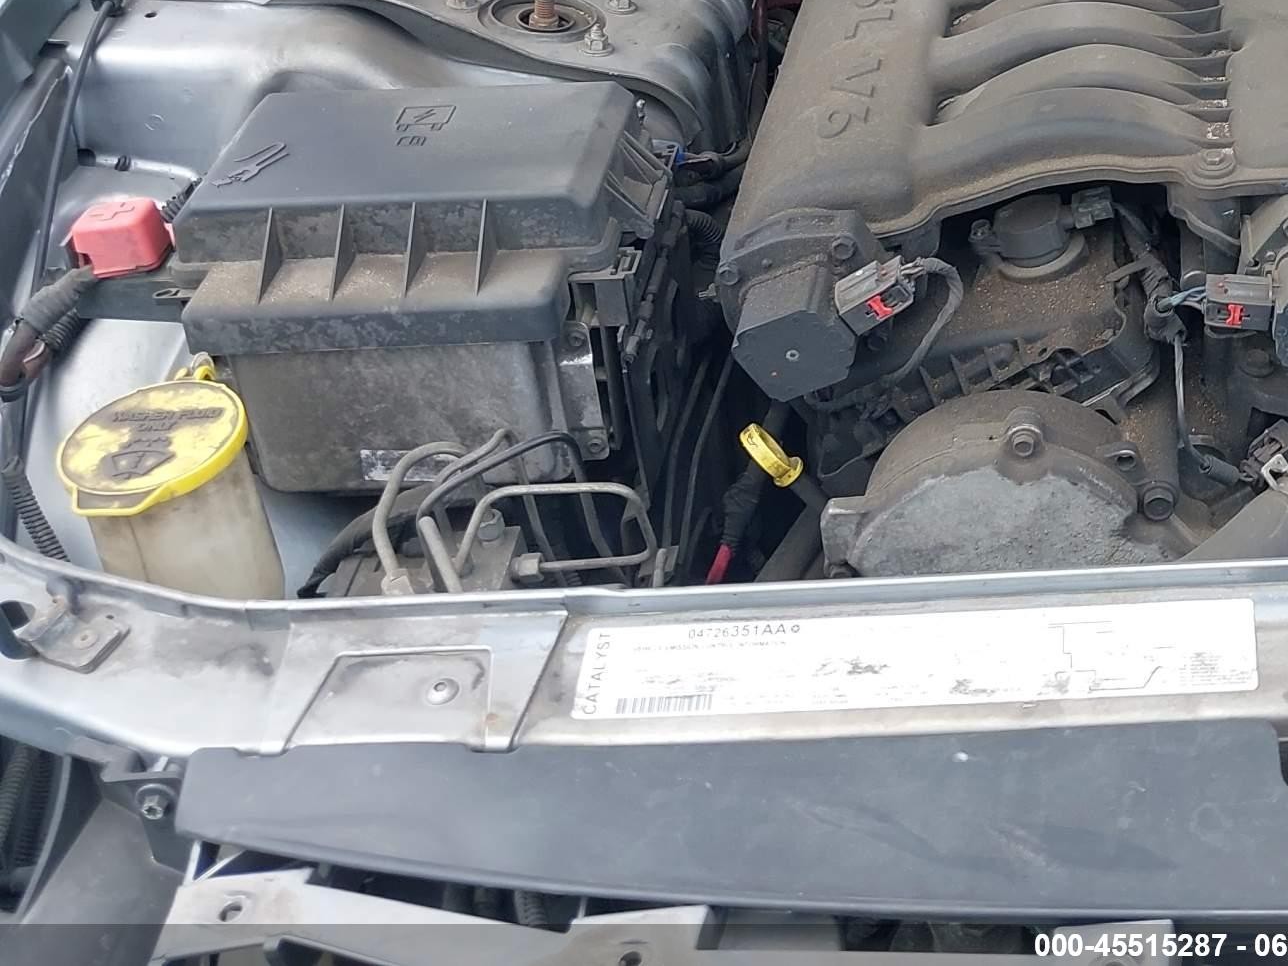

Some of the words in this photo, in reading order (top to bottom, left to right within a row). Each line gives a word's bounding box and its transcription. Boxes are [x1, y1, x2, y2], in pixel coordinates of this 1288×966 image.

[815, 58, 883, 139] V6
[111, 411, 176, 423] WASHER
[178, 408, 223, 420] FLUID
[137, 421, 177, 432] ONLY
[688, 624, 787, 640] 04726351AA
[581, 633, 611, 715] CATALYST
